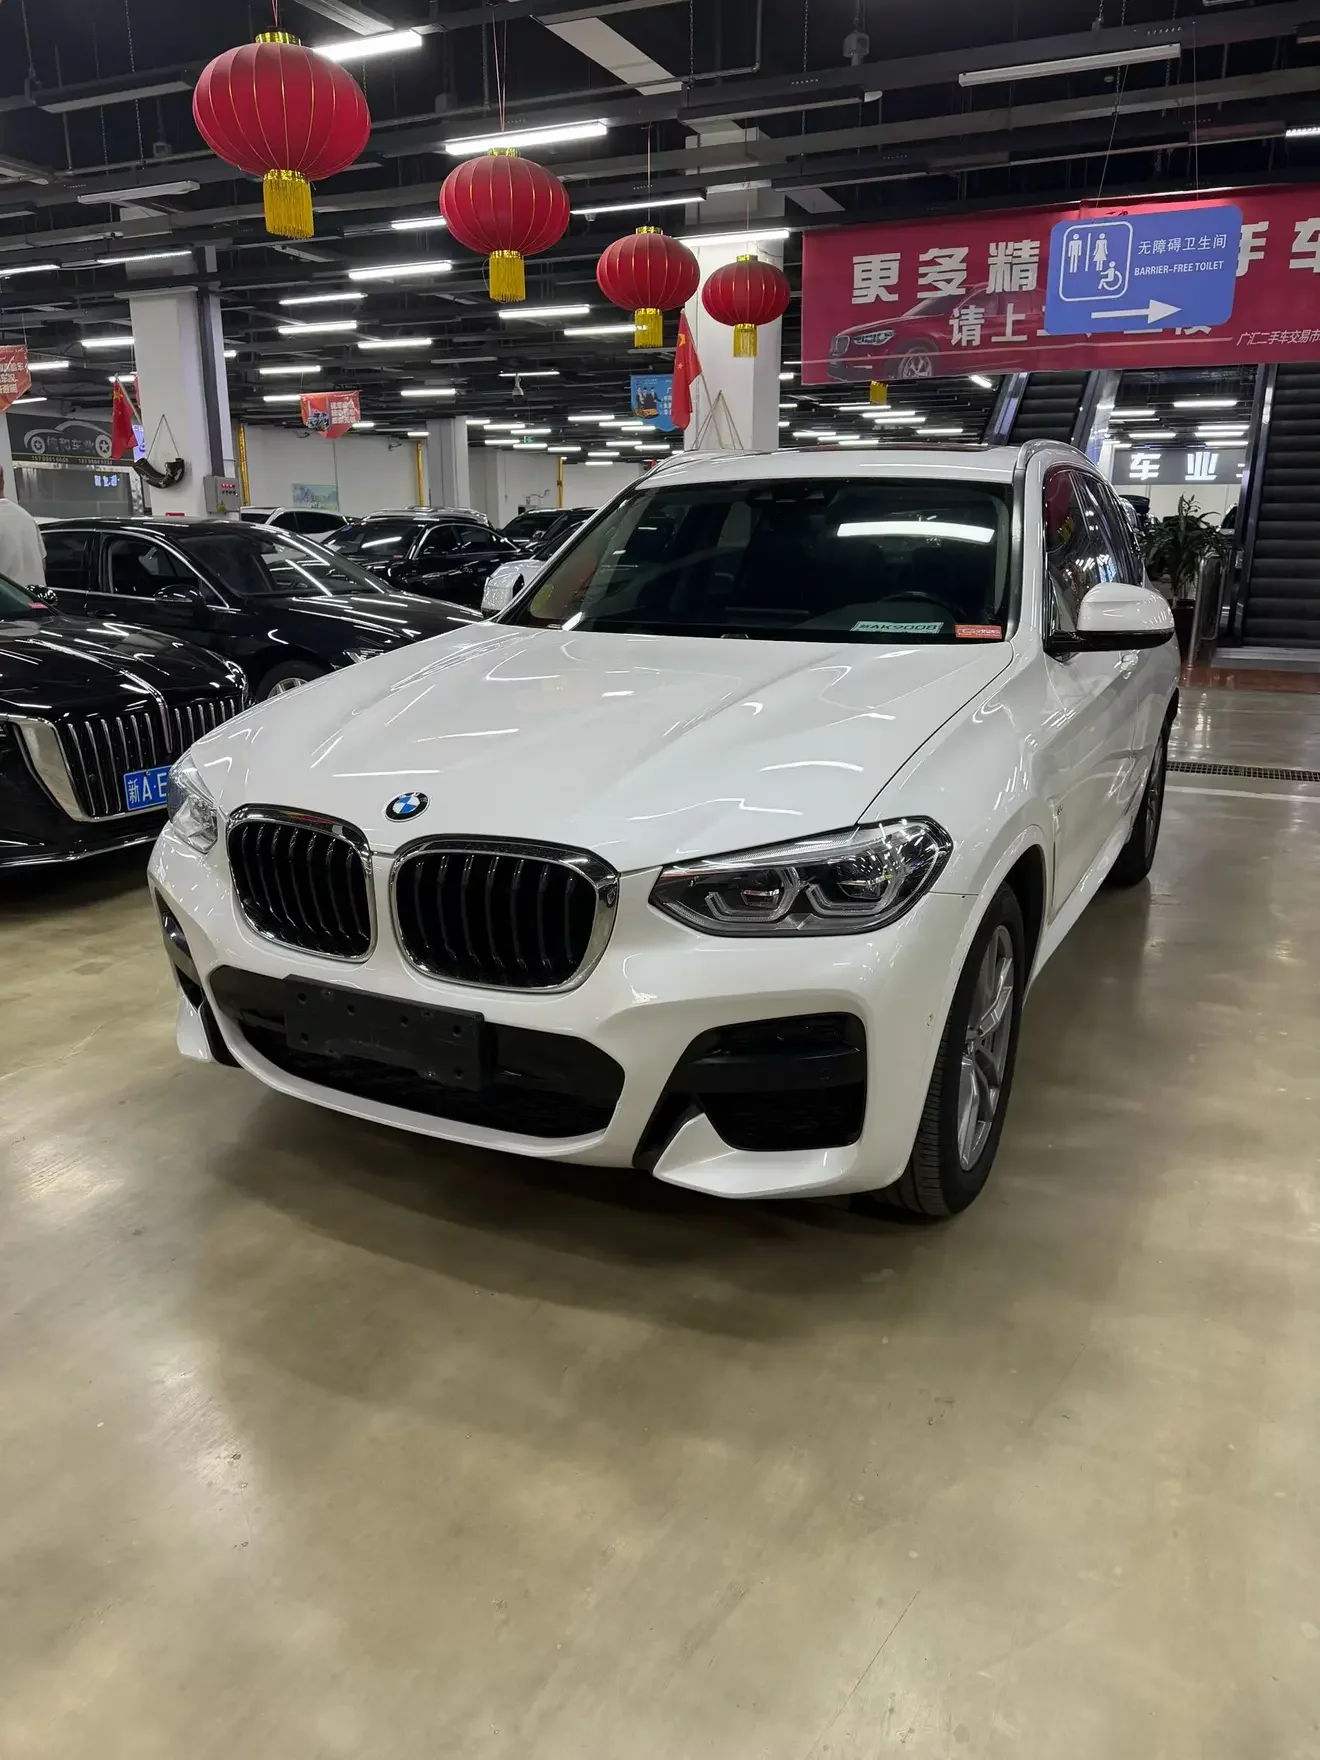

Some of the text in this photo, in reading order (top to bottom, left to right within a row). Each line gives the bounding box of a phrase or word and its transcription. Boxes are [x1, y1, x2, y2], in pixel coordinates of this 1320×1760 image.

[1138, 234, 1227, 255] 无障碍卫生间
[1134, 260, 1224, 276] BARRIER-FREE TOILET
[1237, 329, 1320, 346] 广汇二手车交易市
[1129, 451, 1245, 481] 车业
